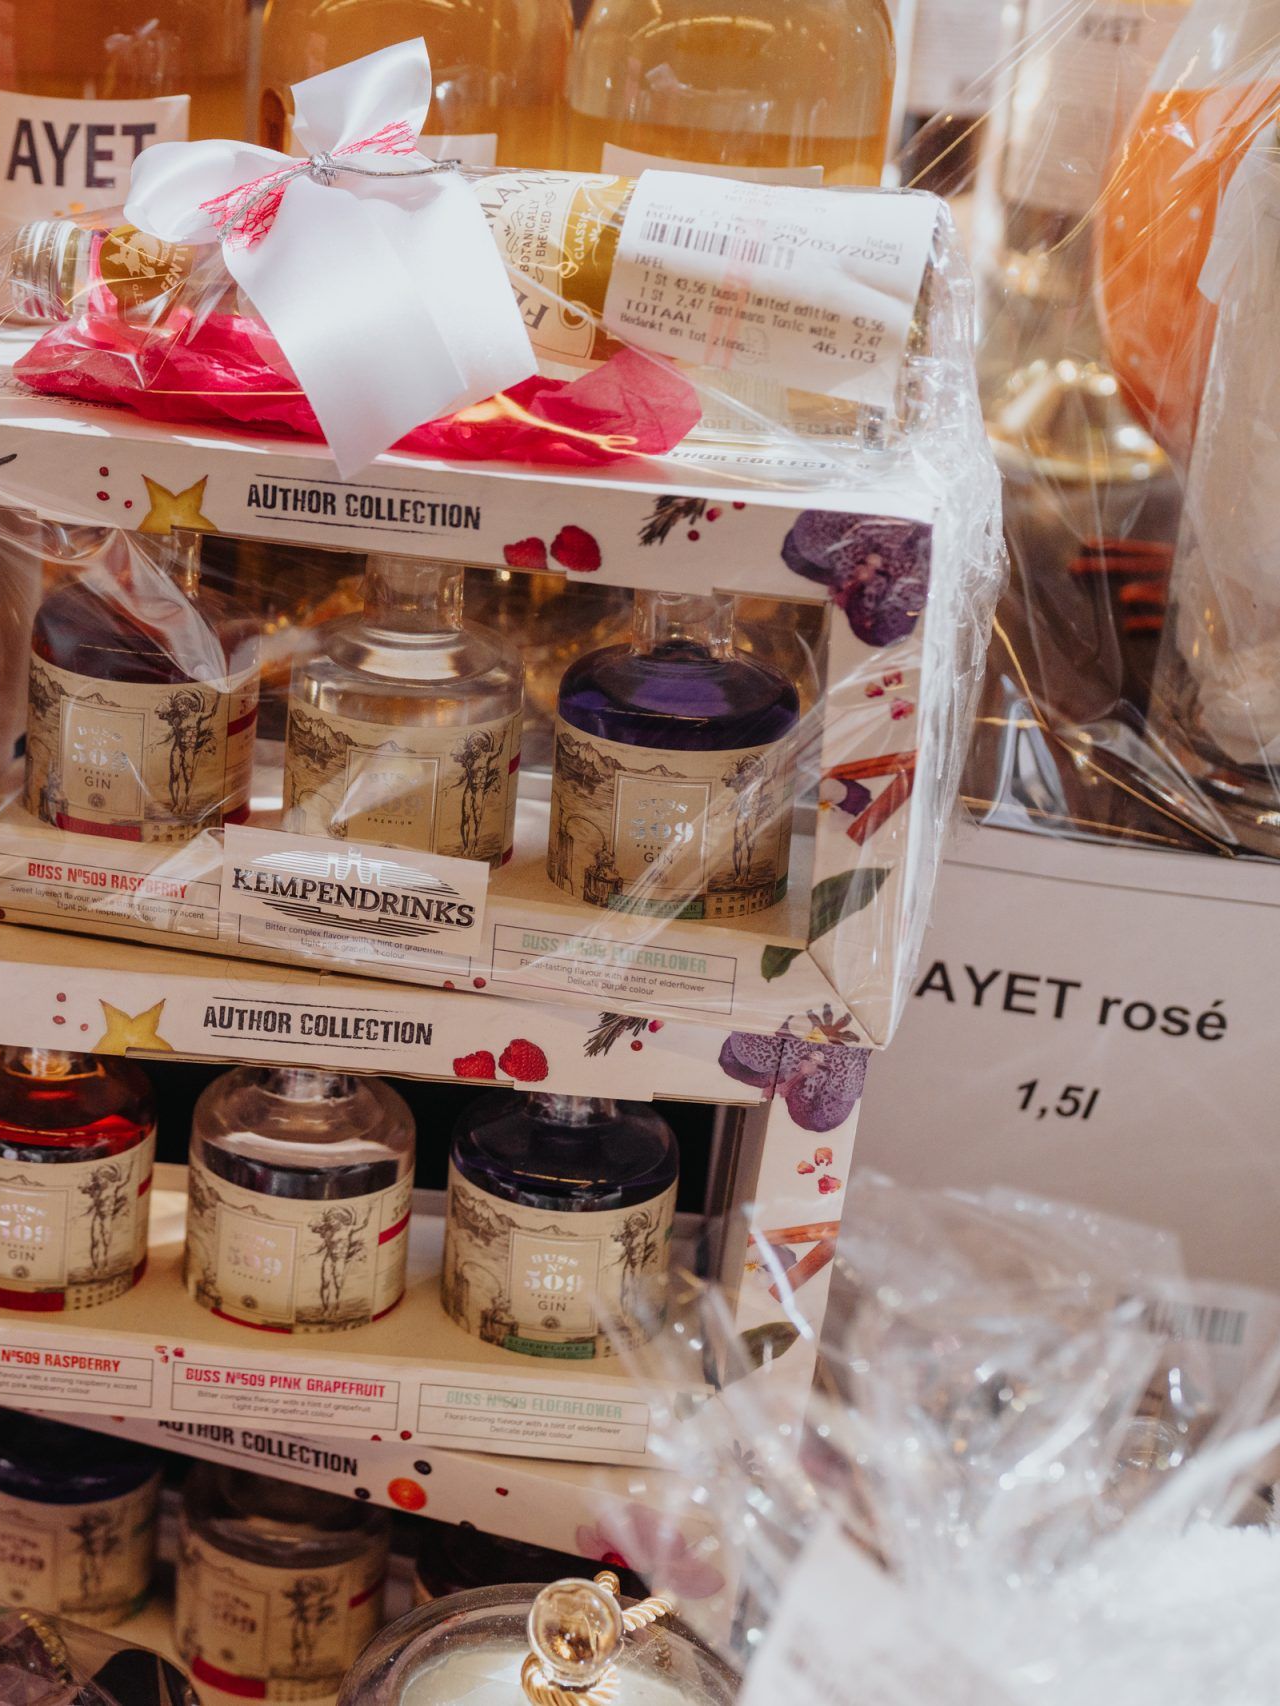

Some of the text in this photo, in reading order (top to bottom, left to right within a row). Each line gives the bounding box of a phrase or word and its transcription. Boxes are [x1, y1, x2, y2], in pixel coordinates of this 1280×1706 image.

[6, 117, 158, 188] AYET
[247, 484, 481, 530] AUTHOR COLLECTION
[84, 775, 112, 790] GIN
[28, 862, 62, 881] BUSS
[232, 868, 475, 928] KEMPENDRINKS
[289, 925, 321, 939] complex
[601, 981, 627, 995] purple
[629, 984, 655, 996] colour
[631, 973, 647, 985] hint
[659, 978, 705, 993] elderflower
[914, 961, 1228, 1041] AYET rosé
[203, 1005, 433, 1046] AUTHOR COLLECTION
[8, 1250, 36, 1262] GIN
[537, 1300, 567, 1313] GIN
[45, 1354, 121, 1374] RASPBERRY
[186, 1367, 221, 1383] BUSS
[270, 1375, 302, 1391] PINK
[306, 1379, 386, 1398] GRAPEFRUIT
[531, 1398, 623, 1419] ELDERFLOWER
[242, 1430, 358, 1477] COLLECTION
